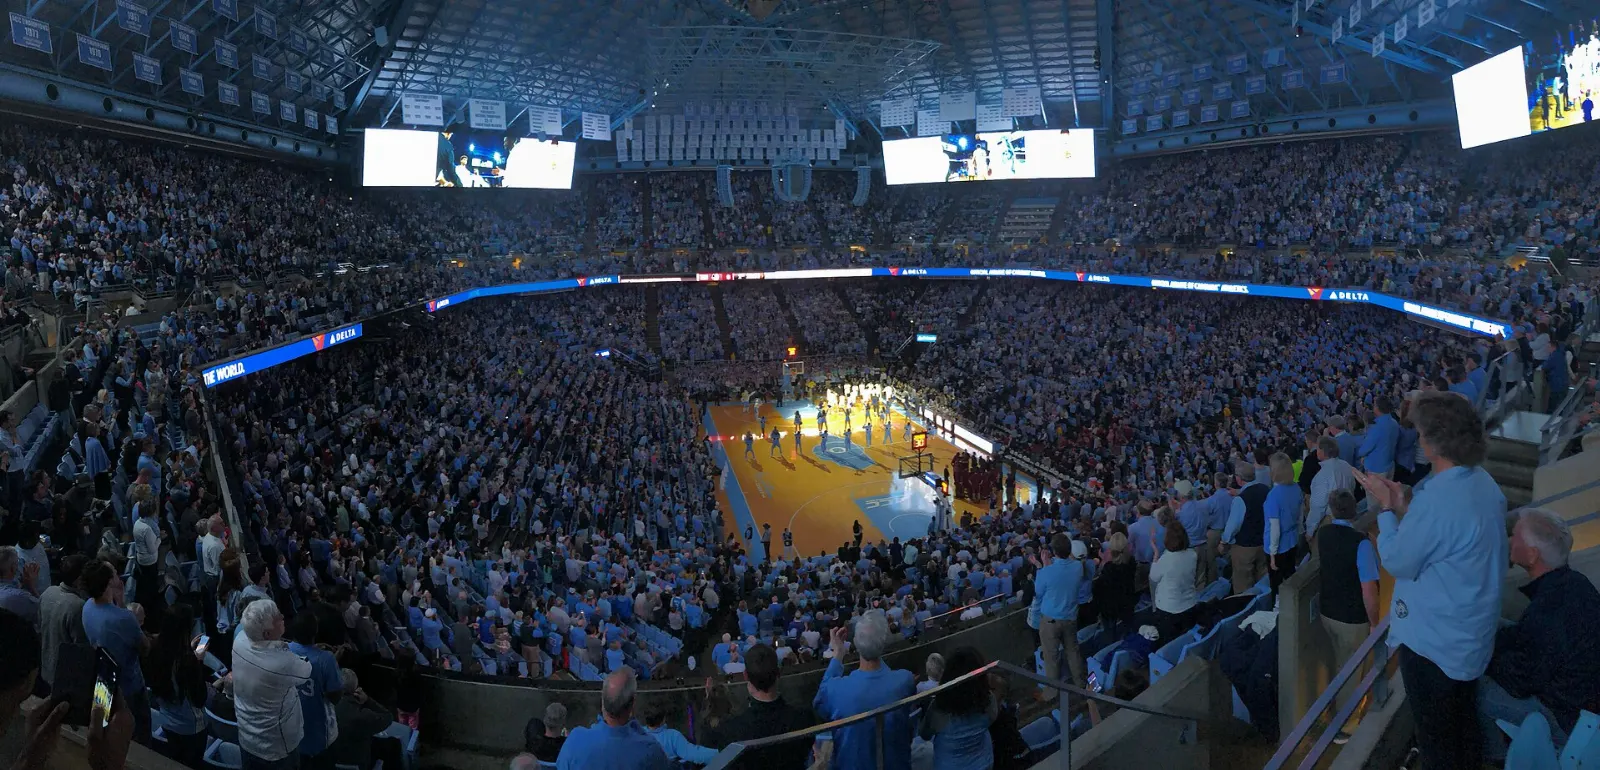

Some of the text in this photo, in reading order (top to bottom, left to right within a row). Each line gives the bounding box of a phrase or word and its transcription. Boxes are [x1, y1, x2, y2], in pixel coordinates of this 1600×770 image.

[1338, 291, 1369, 301] DELTA
[336, 328, 356, 342] DELTA
[202, 361, 245, 386] THE WORLD.
[915, 439, 925, 448] 30
